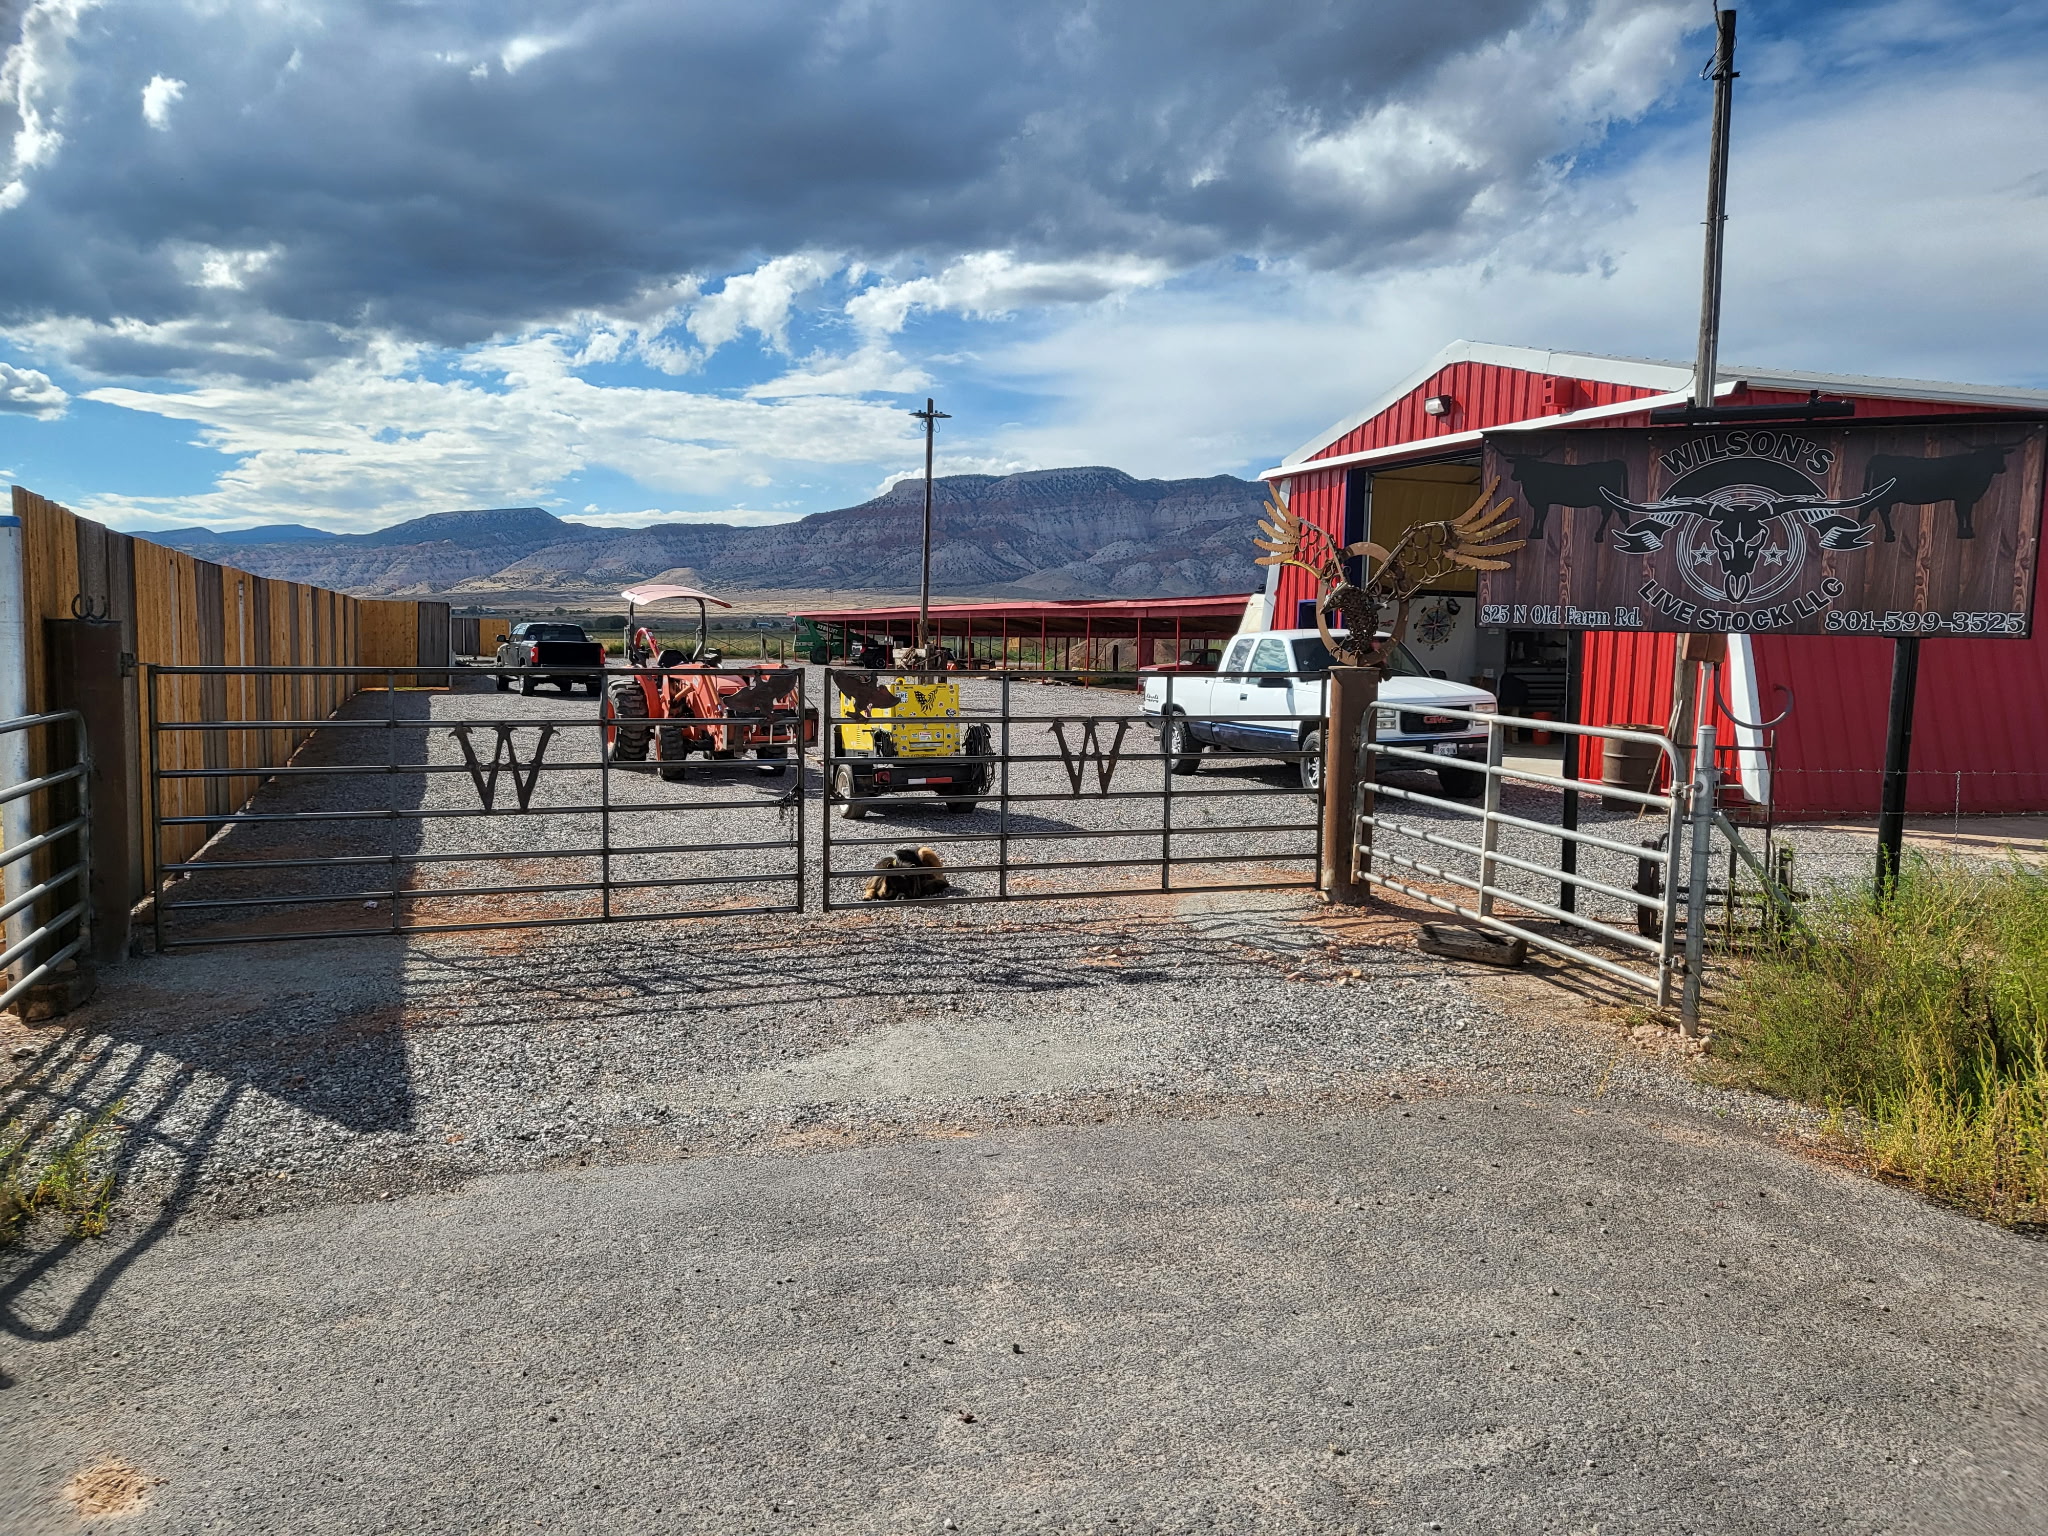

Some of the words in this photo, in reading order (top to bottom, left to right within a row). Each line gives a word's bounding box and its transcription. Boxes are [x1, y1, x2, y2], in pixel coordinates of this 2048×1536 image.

[1658, 431, 1835, 476] WILSON'S
[1481, 605, 1510, 623] 825
[1513, 605, 1527, 623] N
[1530, 605, 1561, 624] Old
[1564, 606, 1610, 626] Farm
[1614, 607, 1643, 626] Rd.
[1638, 579, 1697, 624] LIVE
[1697, 604, 1793, 631] STOCK
[1793, 577, 1844, 618] LLC
[1825, 610, 2025, 633] 801-599-3525
[449, 720, 561, 814] W
[1047, 717, 1132, 799] W
